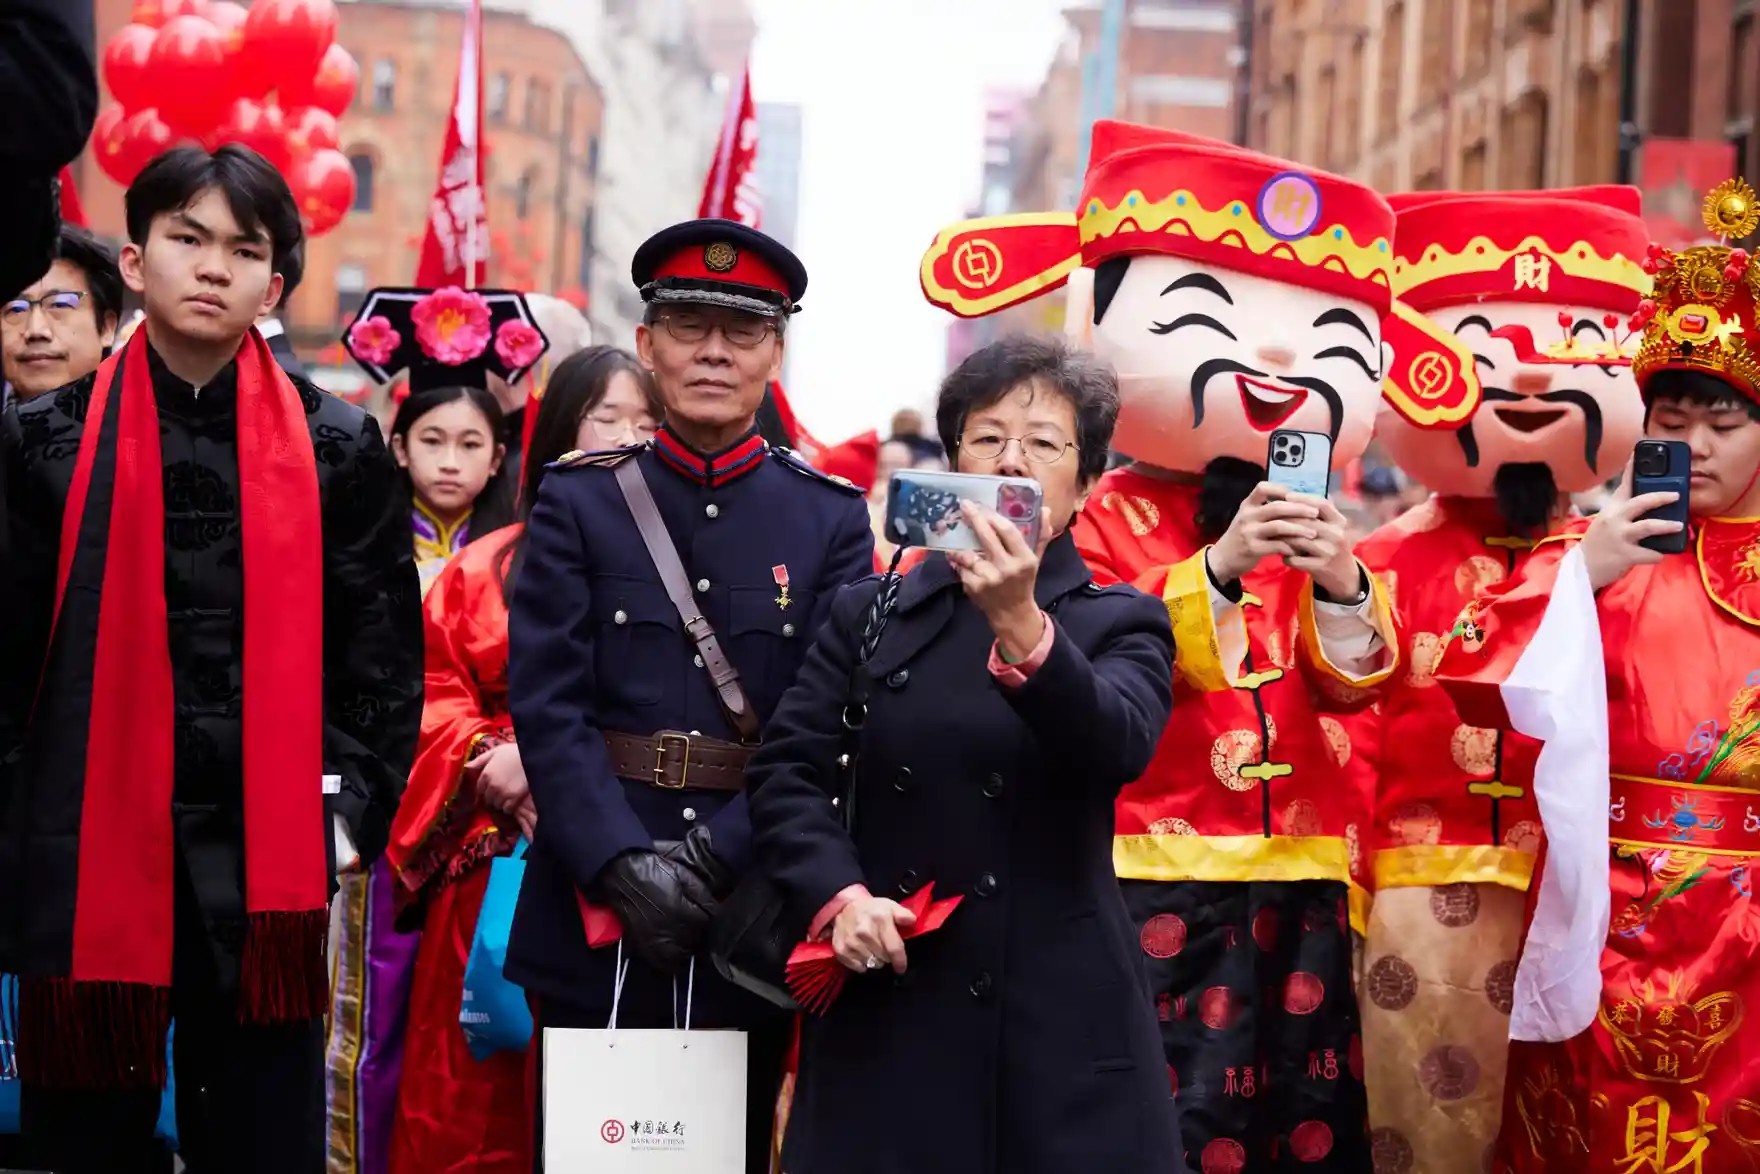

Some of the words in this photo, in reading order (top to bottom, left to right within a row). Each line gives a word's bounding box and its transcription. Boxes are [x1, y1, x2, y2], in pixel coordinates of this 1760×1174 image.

[1513, 253, 1551, 293] 財
[1654, 1052, 1680, 1077] 財
[1613, 1090, 1718, 1174] 財
